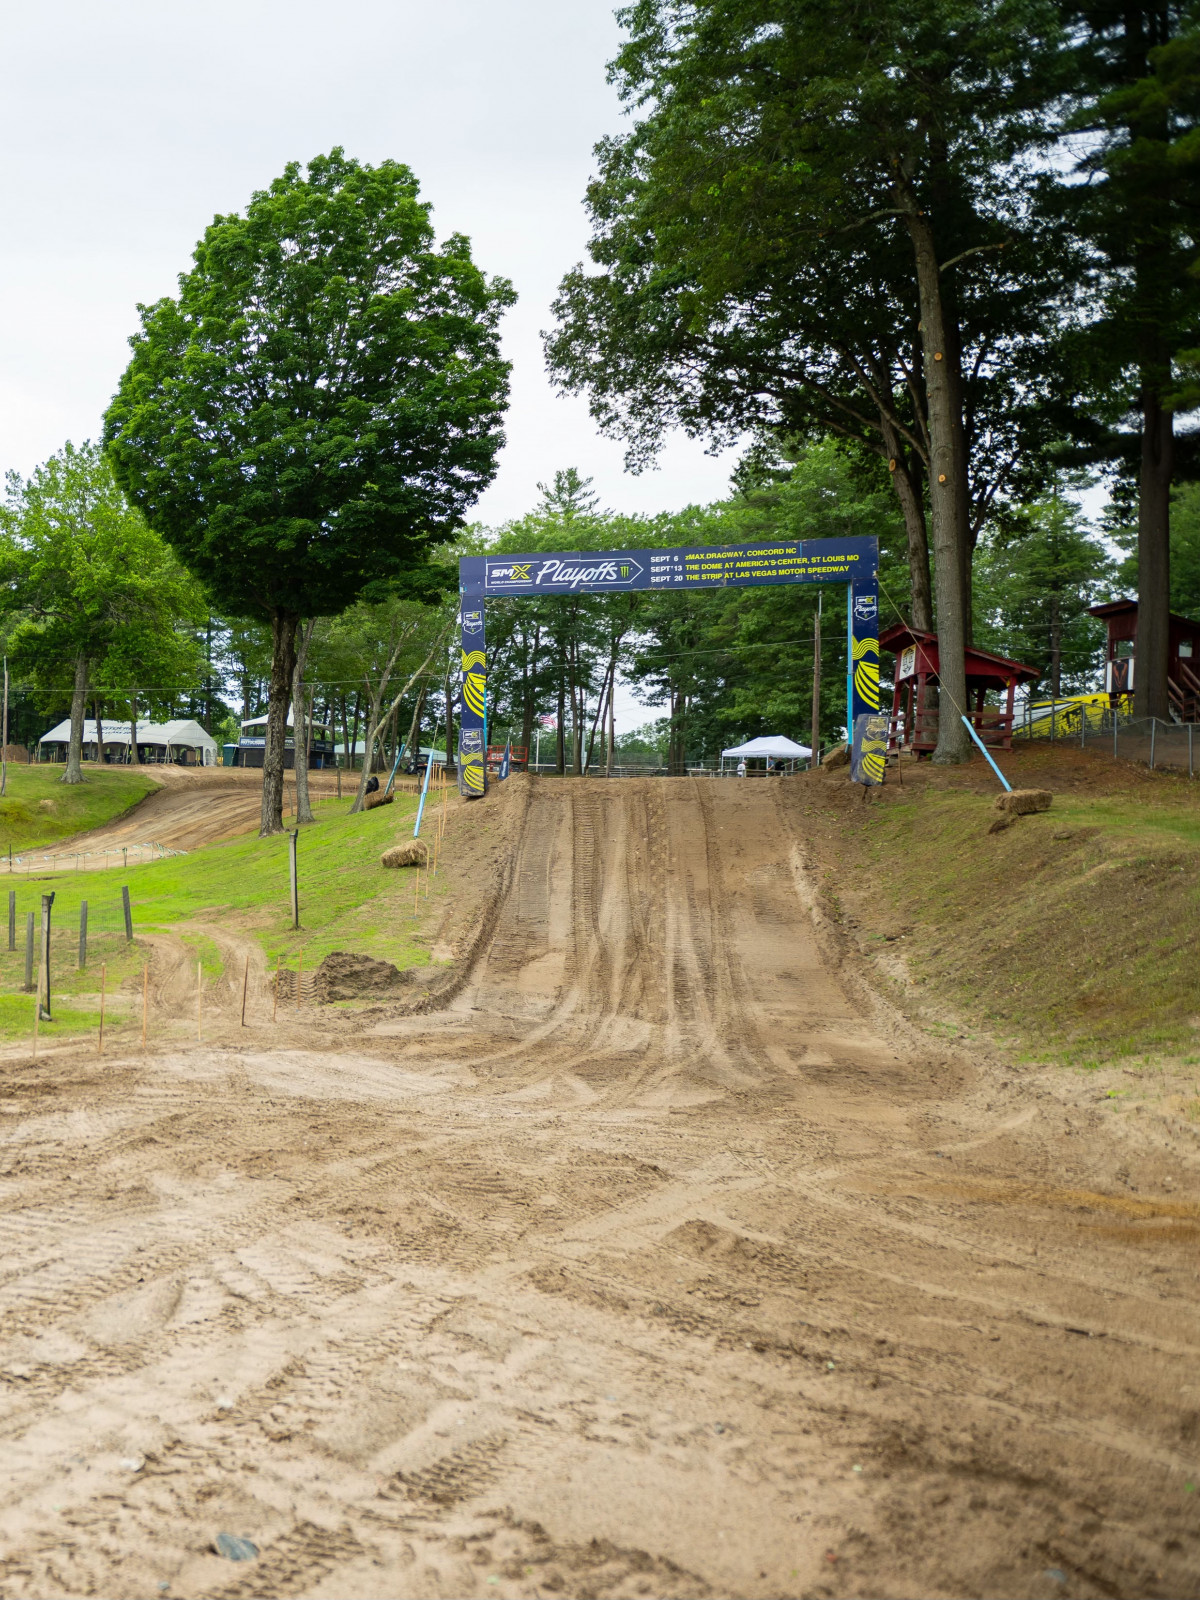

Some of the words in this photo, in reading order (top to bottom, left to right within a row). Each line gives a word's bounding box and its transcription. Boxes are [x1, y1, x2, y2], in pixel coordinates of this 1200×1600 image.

[706, 551, 746, 559] DRAGWAY,
[746, 548, 784, 556] CONCORD
[736, 560, 776, 568] AMERICA'S
[491, 565, 532, 579] SMX
[536, 560, 618, 588] Playoffs
[808, 566, 850, 574] SPEEDWAY
